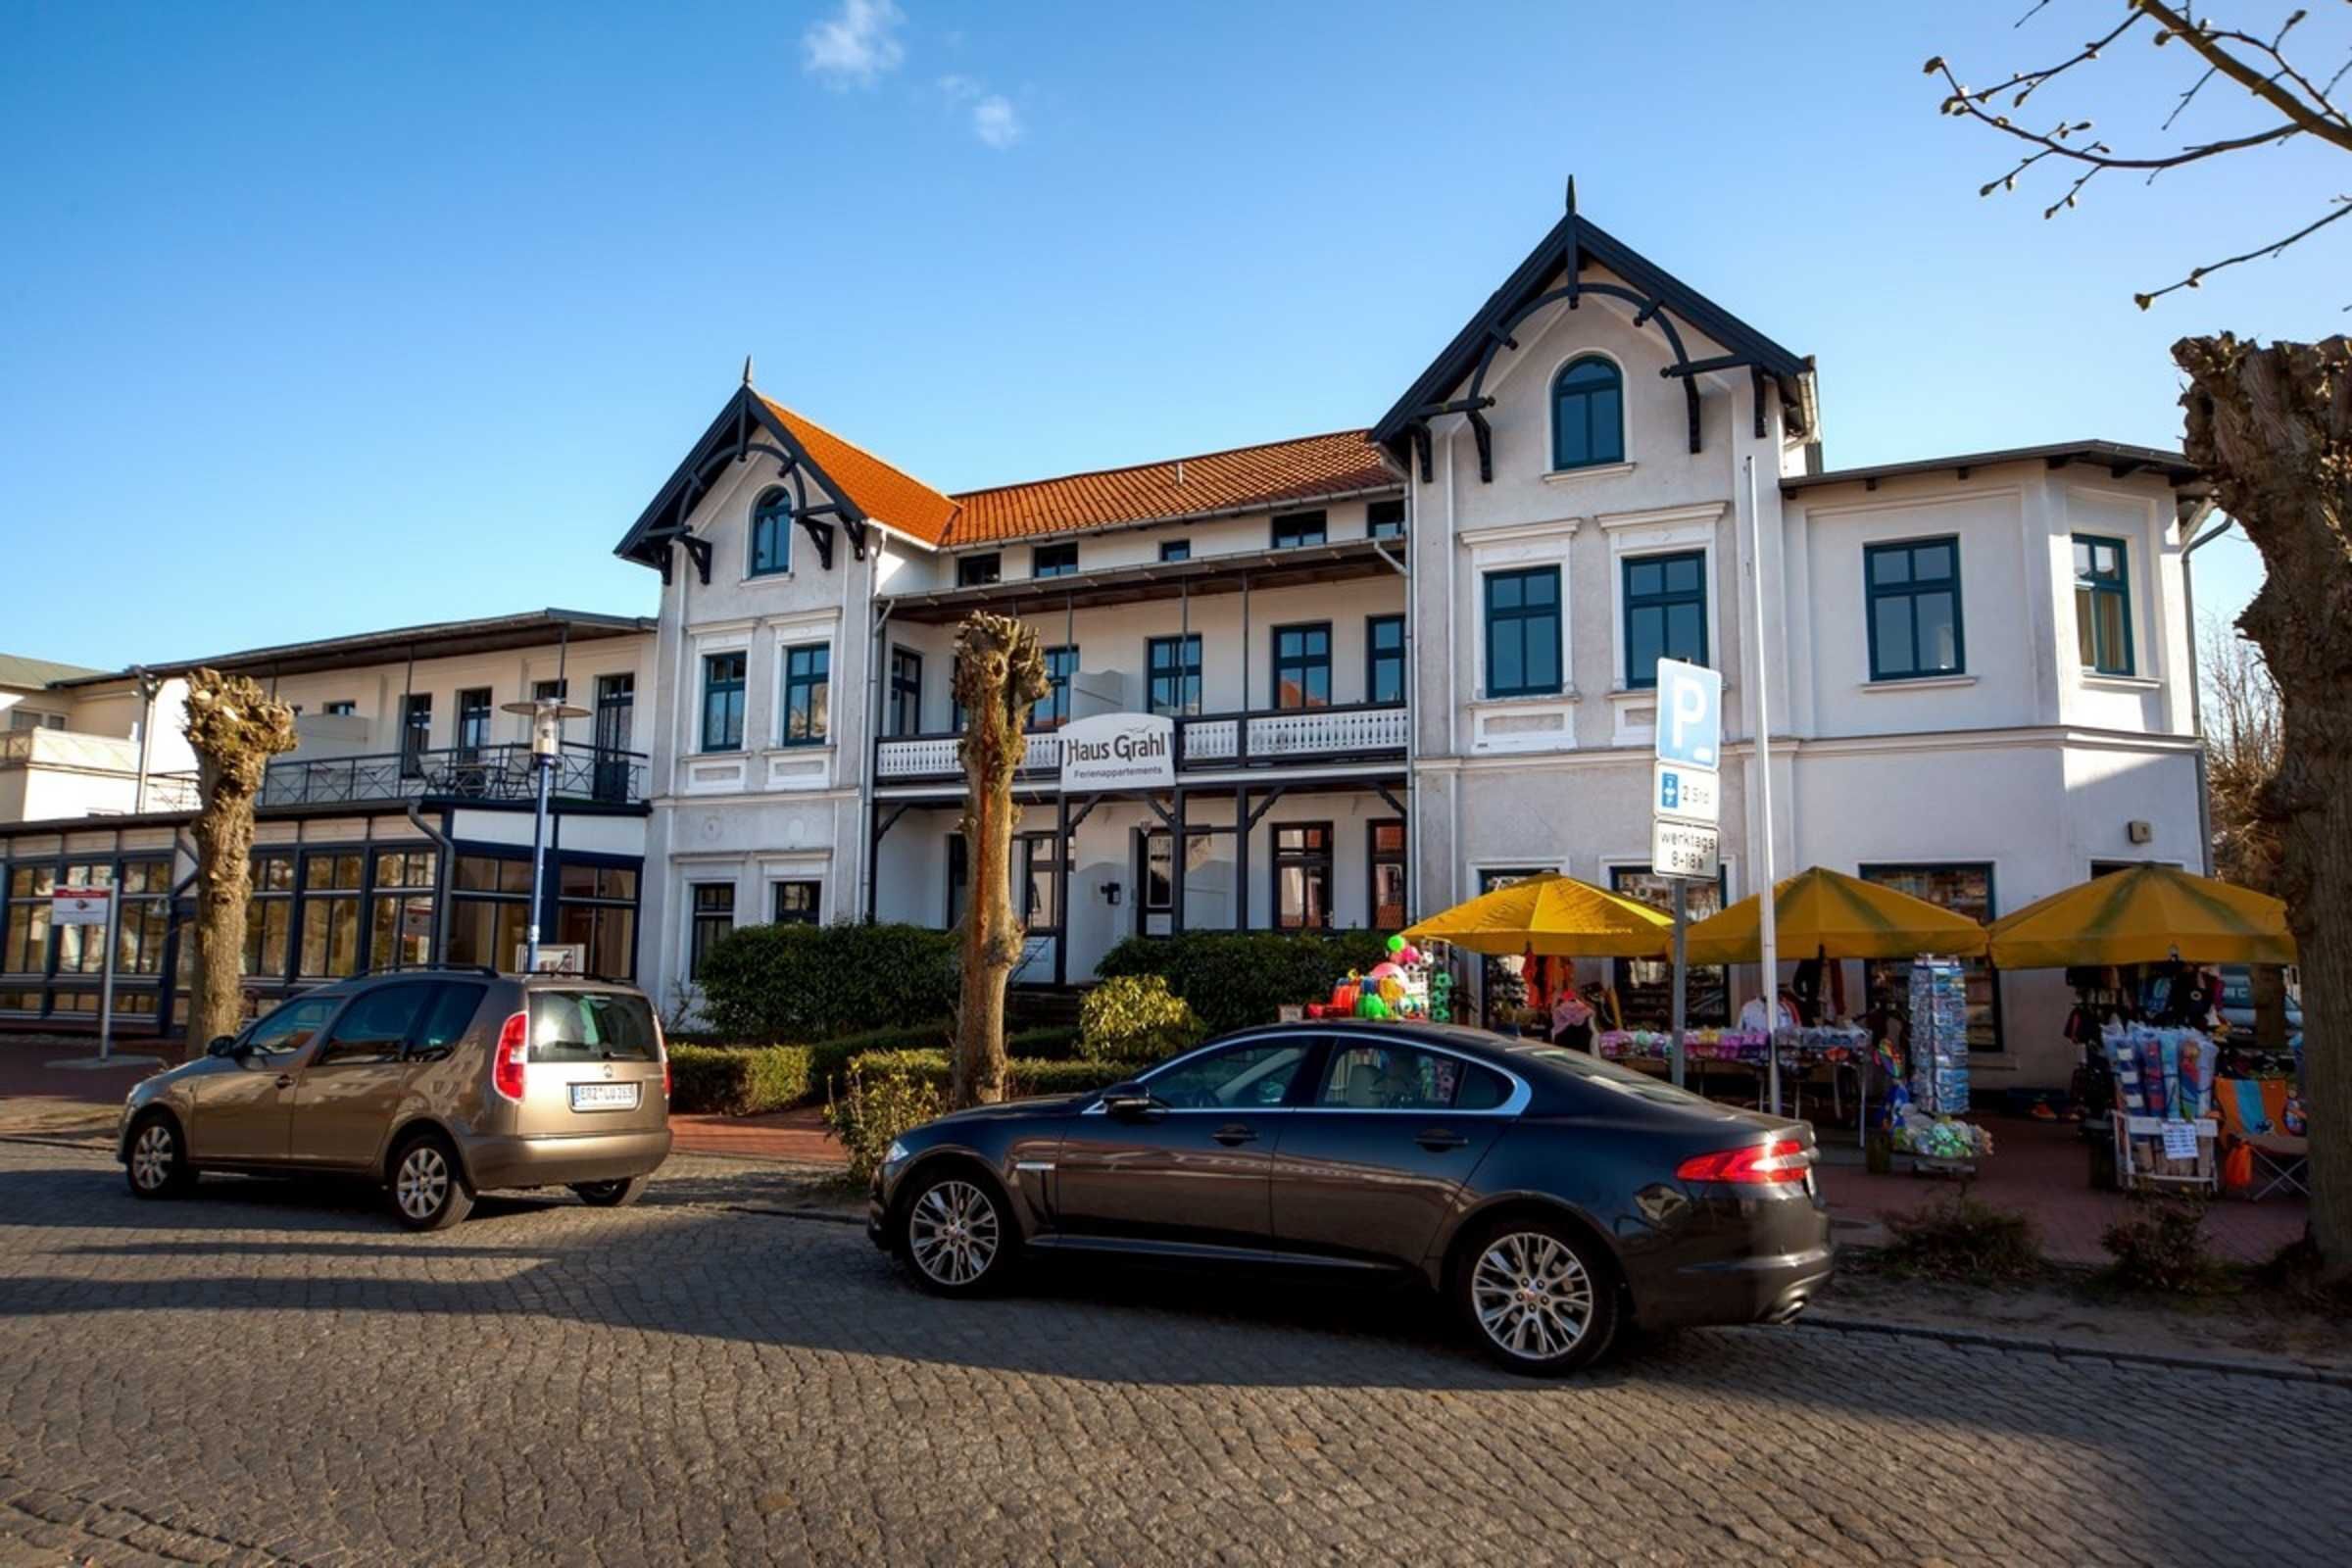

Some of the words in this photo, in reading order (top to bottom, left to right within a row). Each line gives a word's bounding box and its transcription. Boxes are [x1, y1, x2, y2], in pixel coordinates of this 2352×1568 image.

[1672, 674, 1707, 750] P
[1066, 738, 1109, 766] Haus
[1114, 732, 1165, 762] Grahl
[1074, 765, 1163, 779] Ferienappartements
[1682, 784, 1690, 802] 2
[1660, 831, 1716, 854] werktags
